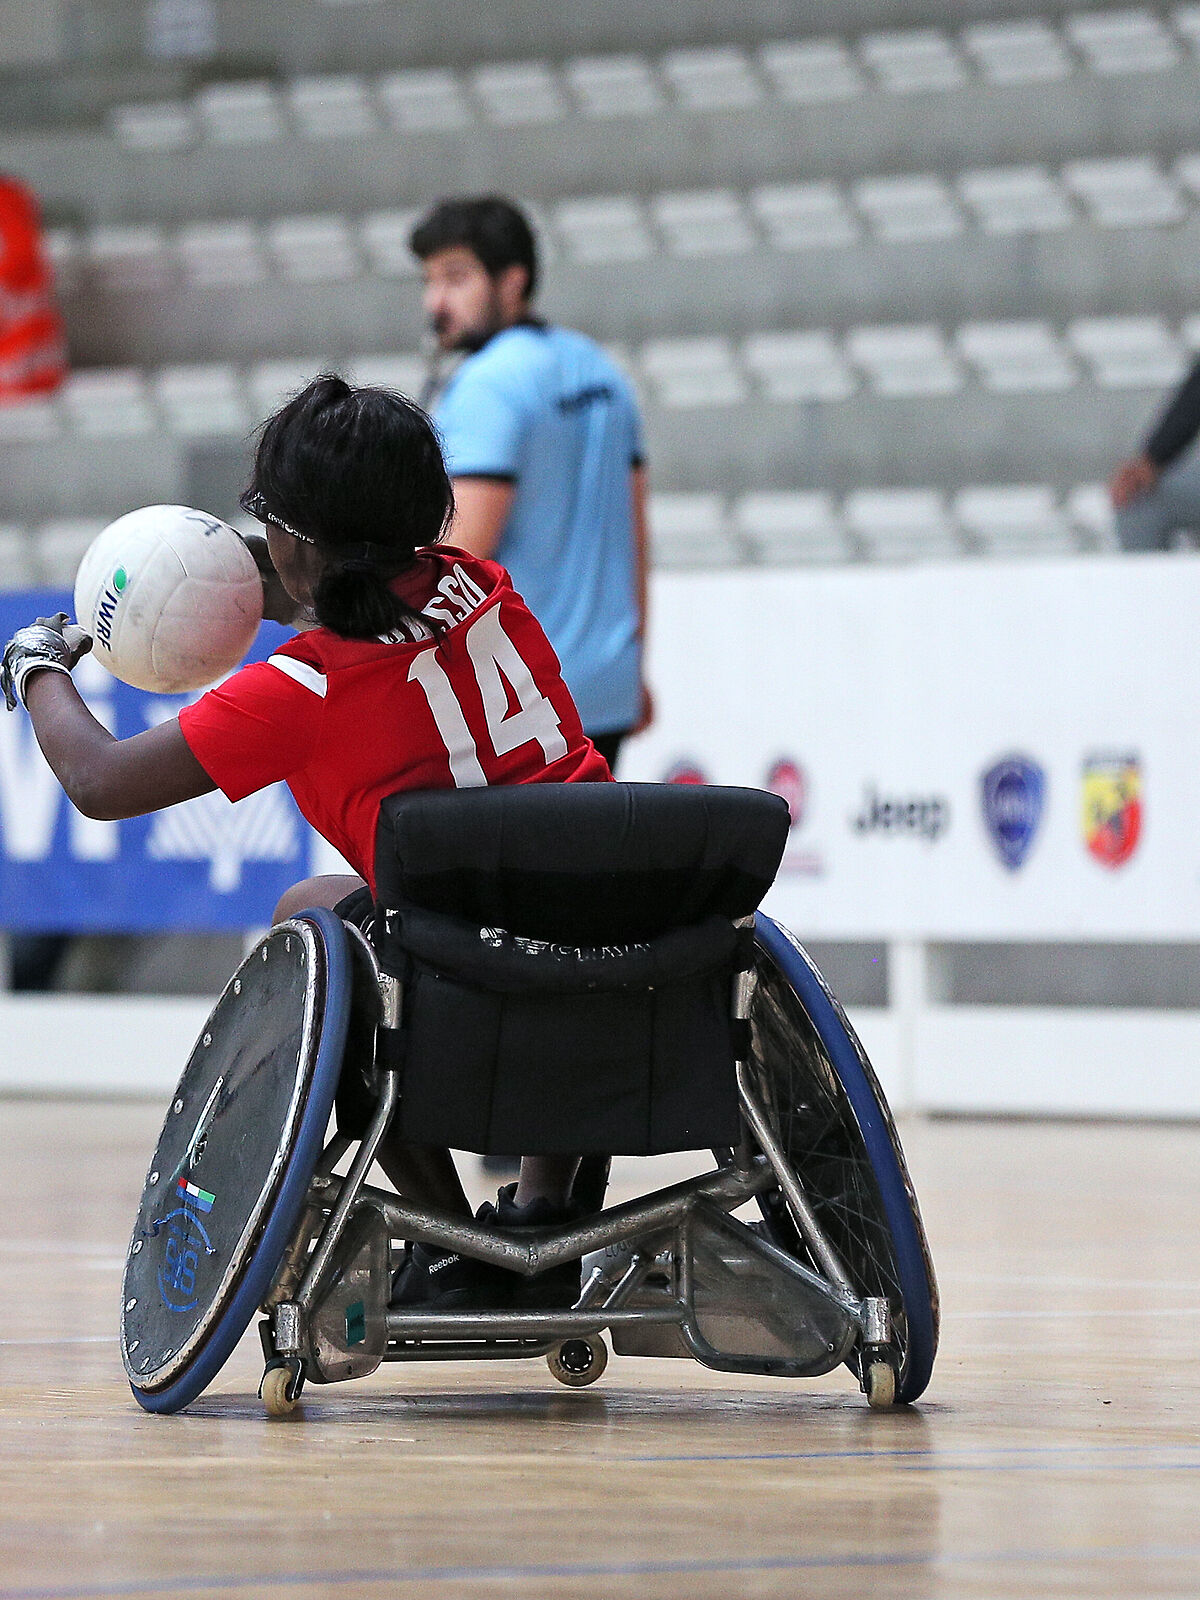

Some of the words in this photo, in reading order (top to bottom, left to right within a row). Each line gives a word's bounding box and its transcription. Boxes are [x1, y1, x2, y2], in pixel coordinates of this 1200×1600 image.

[97, 590, 118, 653] IWRF
[406, 601, 569, 789] 14
[428, 1253, 460, 1275] Reebok
